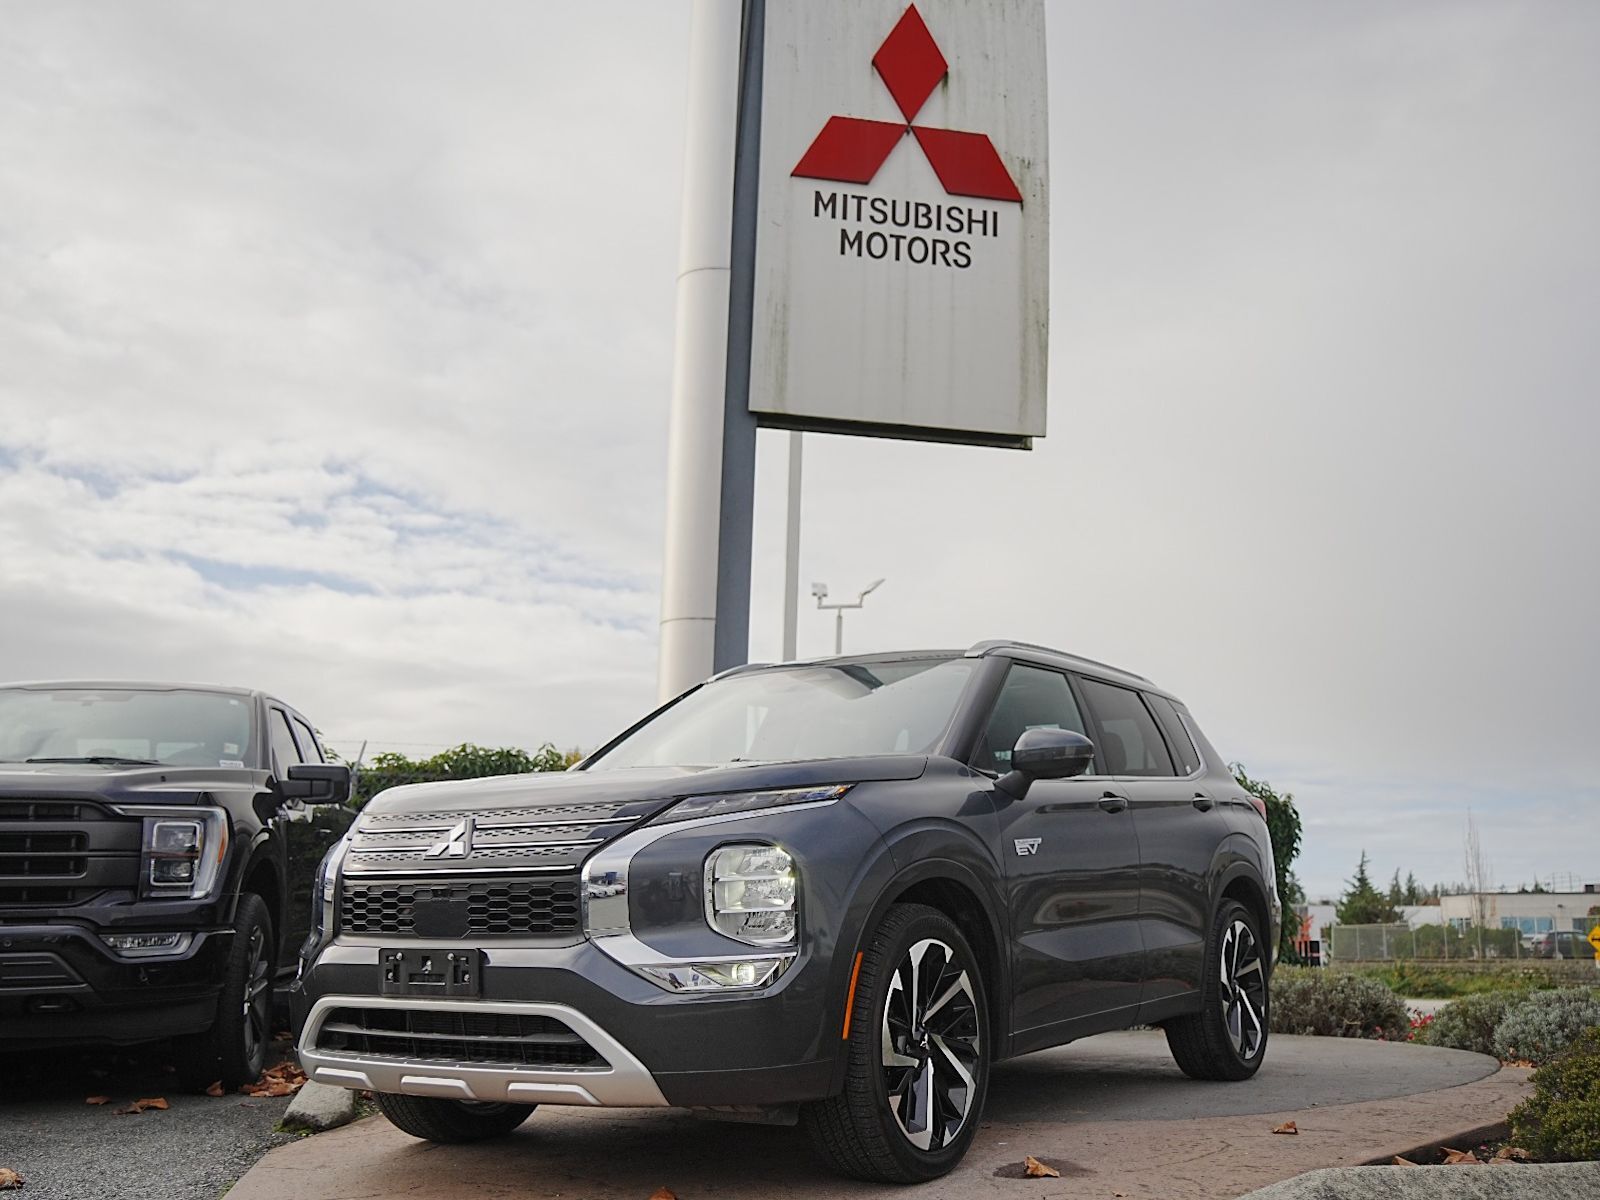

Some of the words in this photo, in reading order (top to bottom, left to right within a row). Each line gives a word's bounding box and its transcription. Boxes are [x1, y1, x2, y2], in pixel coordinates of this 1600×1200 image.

[814, 190, 998, 238] MITSUBISHI
[840, 228, 972, 269] MOTORS
[1015, 843, 1038, 856] EV
